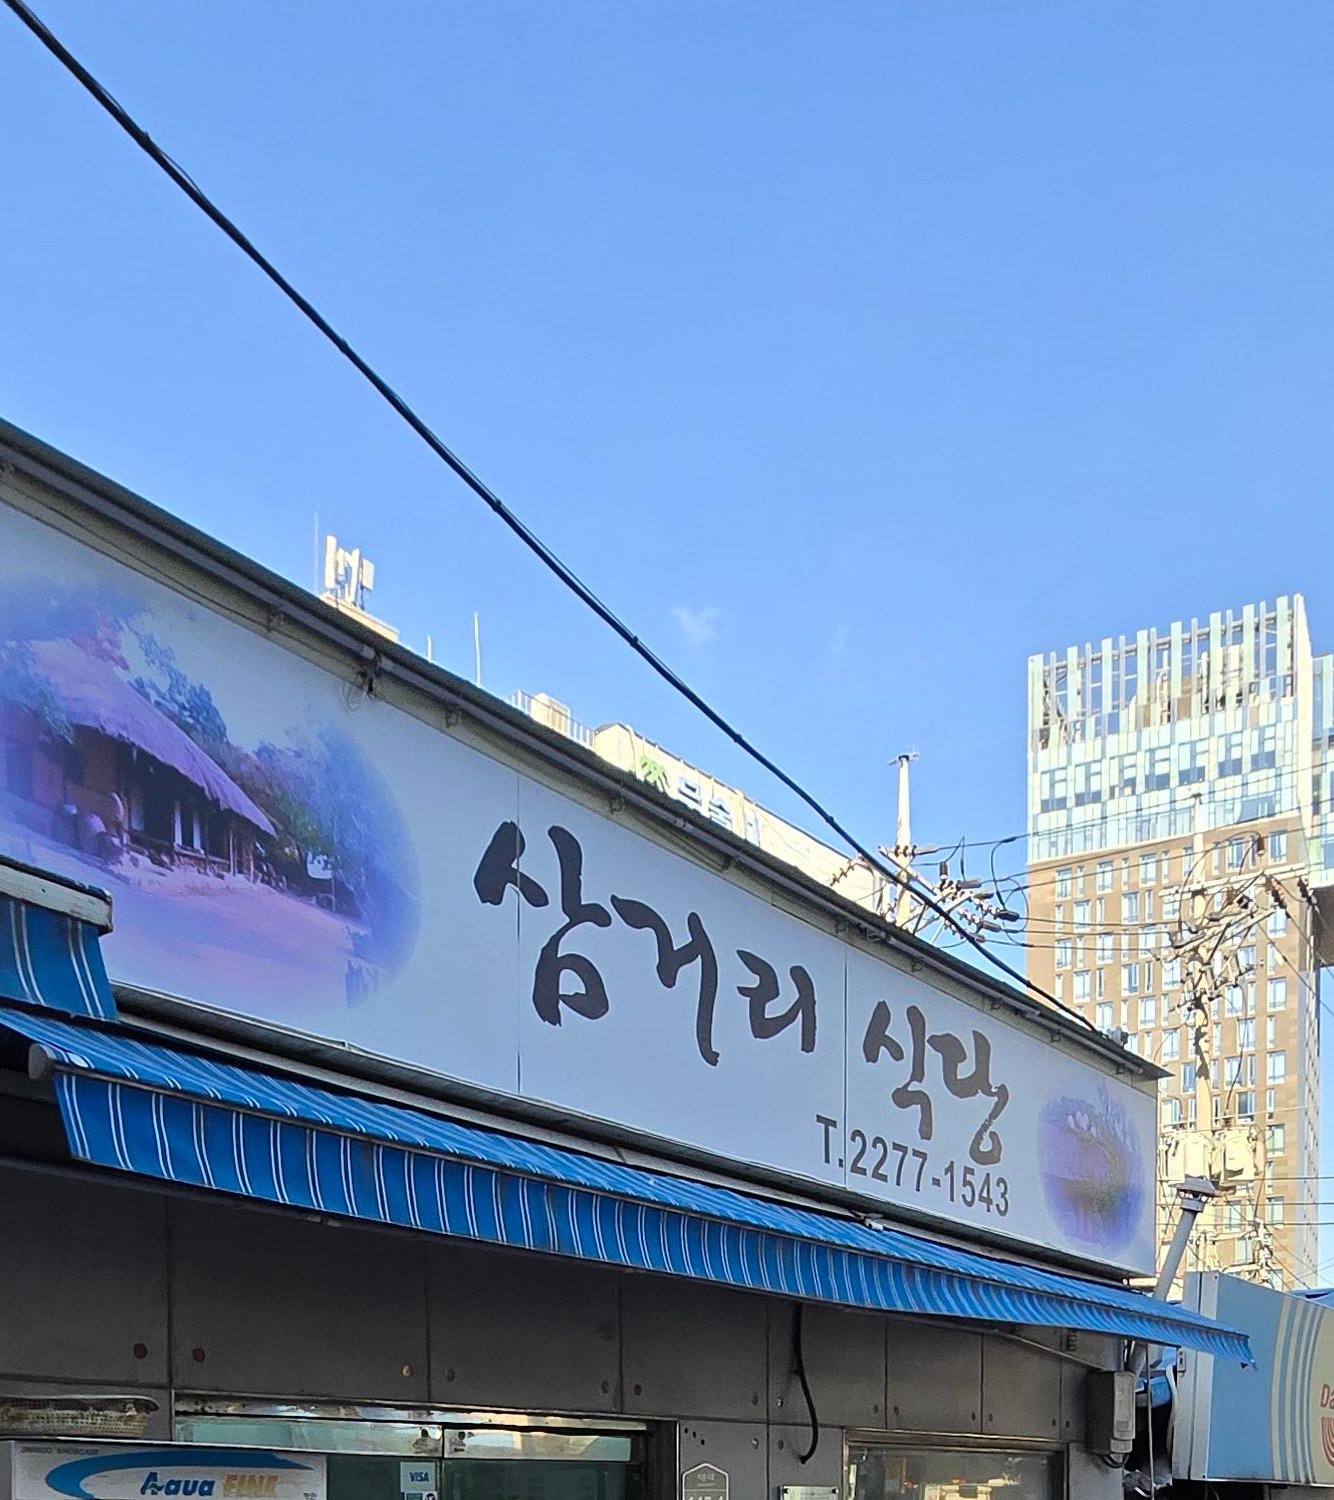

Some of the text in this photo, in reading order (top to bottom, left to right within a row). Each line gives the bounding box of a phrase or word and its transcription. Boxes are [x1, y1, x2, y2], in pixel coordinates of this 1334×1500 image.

[473, 820, 1010, 1166] 삼거리 식당
[815, 1114, 1011, 1217] T.2277-1543
[409, 1471, 429, 1482] VISA
